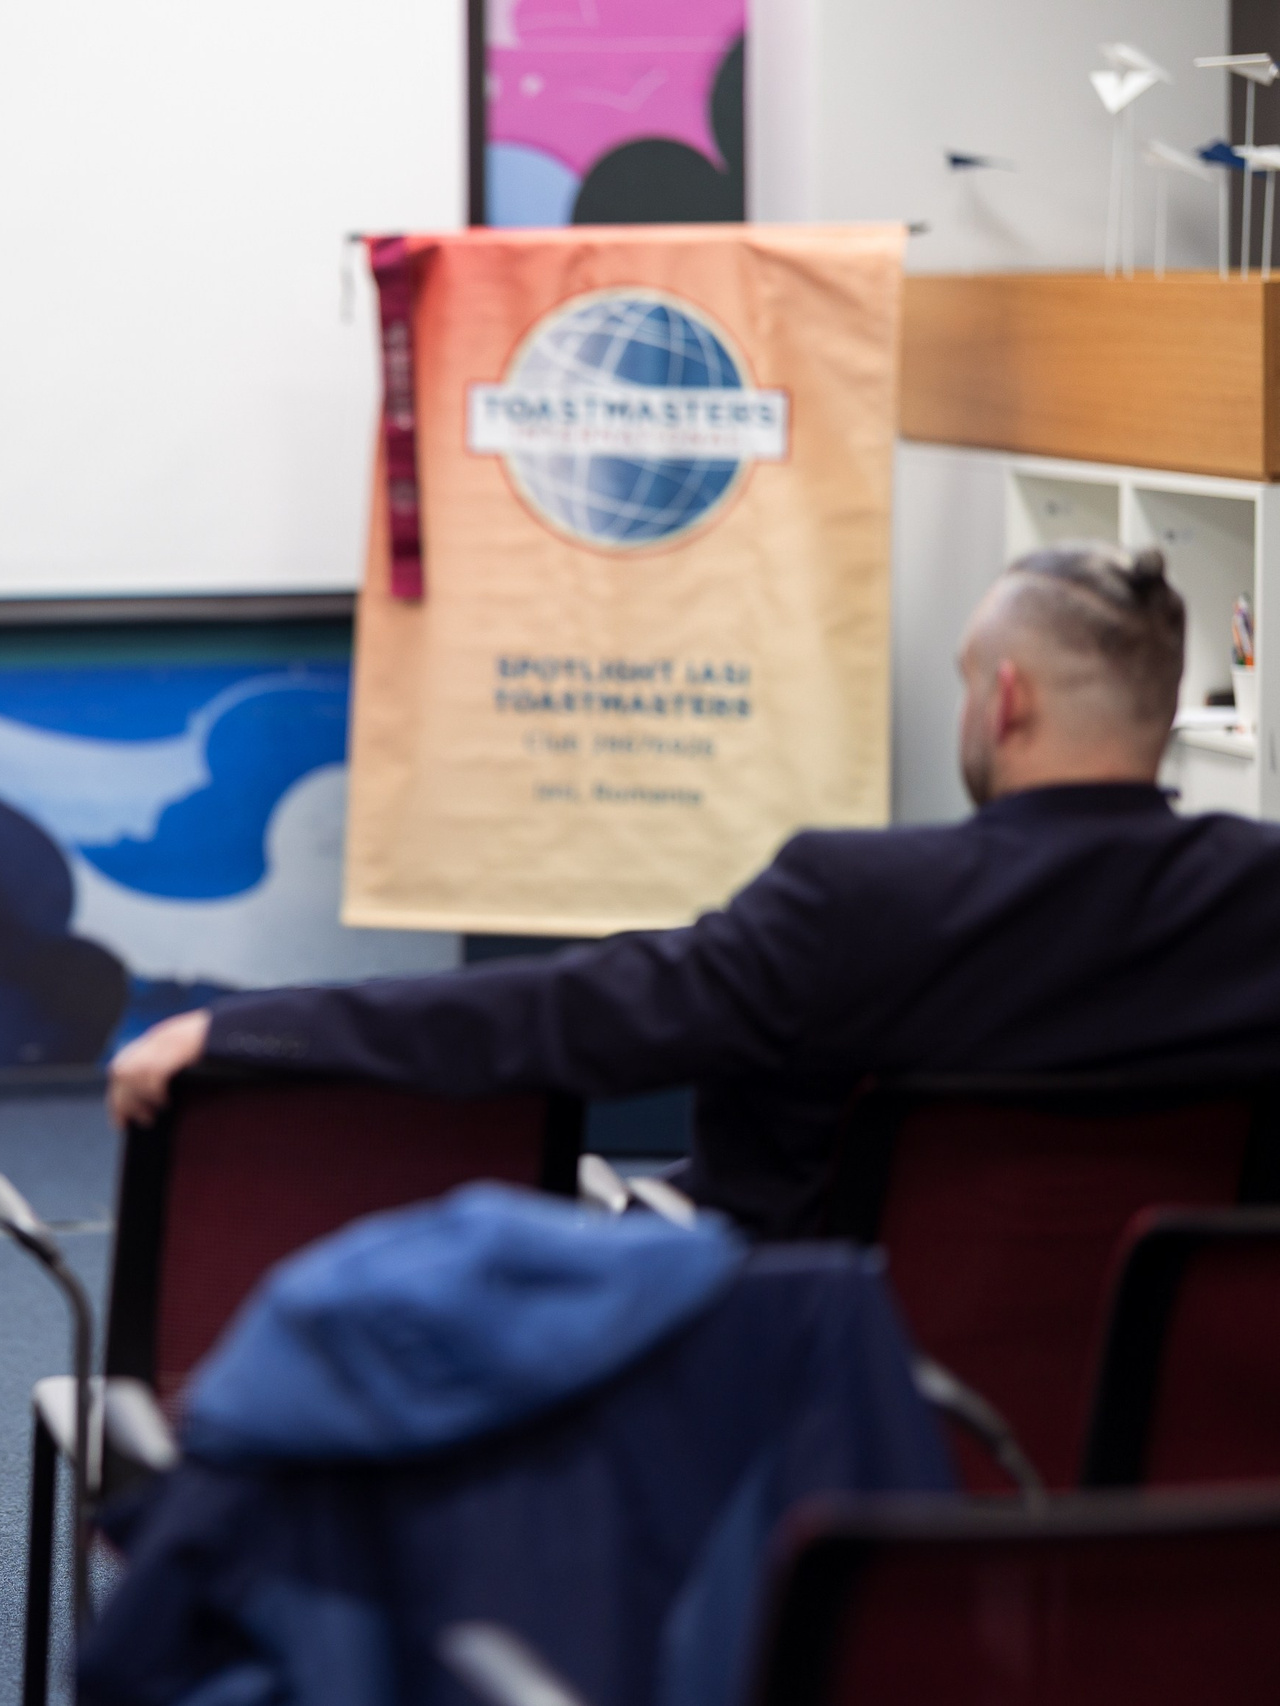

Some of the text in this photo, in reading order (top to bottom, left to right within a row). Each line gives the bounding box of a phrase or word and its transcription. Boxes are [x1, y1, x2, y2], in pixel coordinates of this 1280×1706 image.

[485, 394, 776, 427] TOASTMASTERS
[494, 656, 674, 682] SPOTLIGHT
[494, 689, 753, 719] TOASTMASTERS
